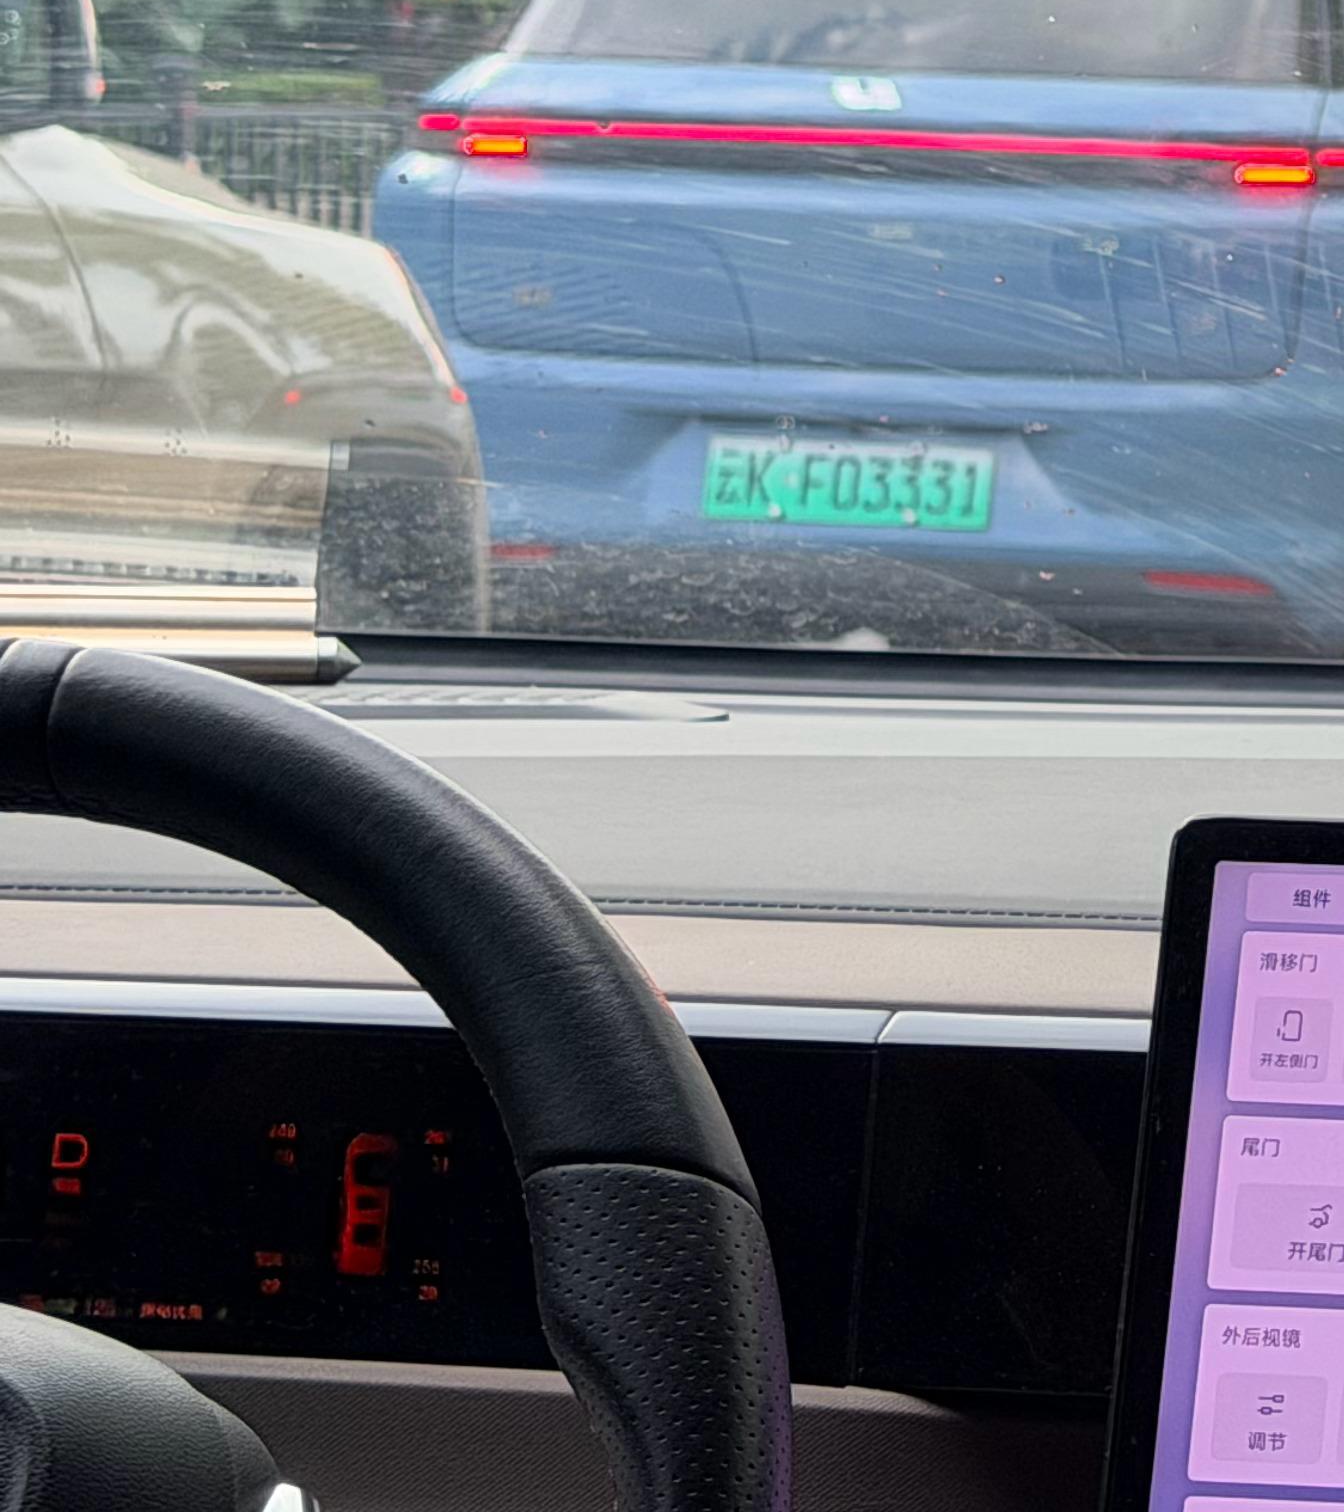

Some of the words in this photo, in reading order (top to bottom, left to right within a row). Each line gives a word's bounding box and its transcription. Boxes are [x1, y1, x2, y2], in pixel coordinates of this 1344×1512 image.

[1292, 889, 1331, 909] 组件
[1259, 952, 1318, 973] 滑移门
[1258, 1052, 1319, 1070] 开左侧门
[52, 1132, 89, 1169] D
[1240, 1137, 1281, 1158] 尾门
[1221, 1325, 1302, 1348] 外后视镜
[1247, 1431, 1287, 1451] 调节
